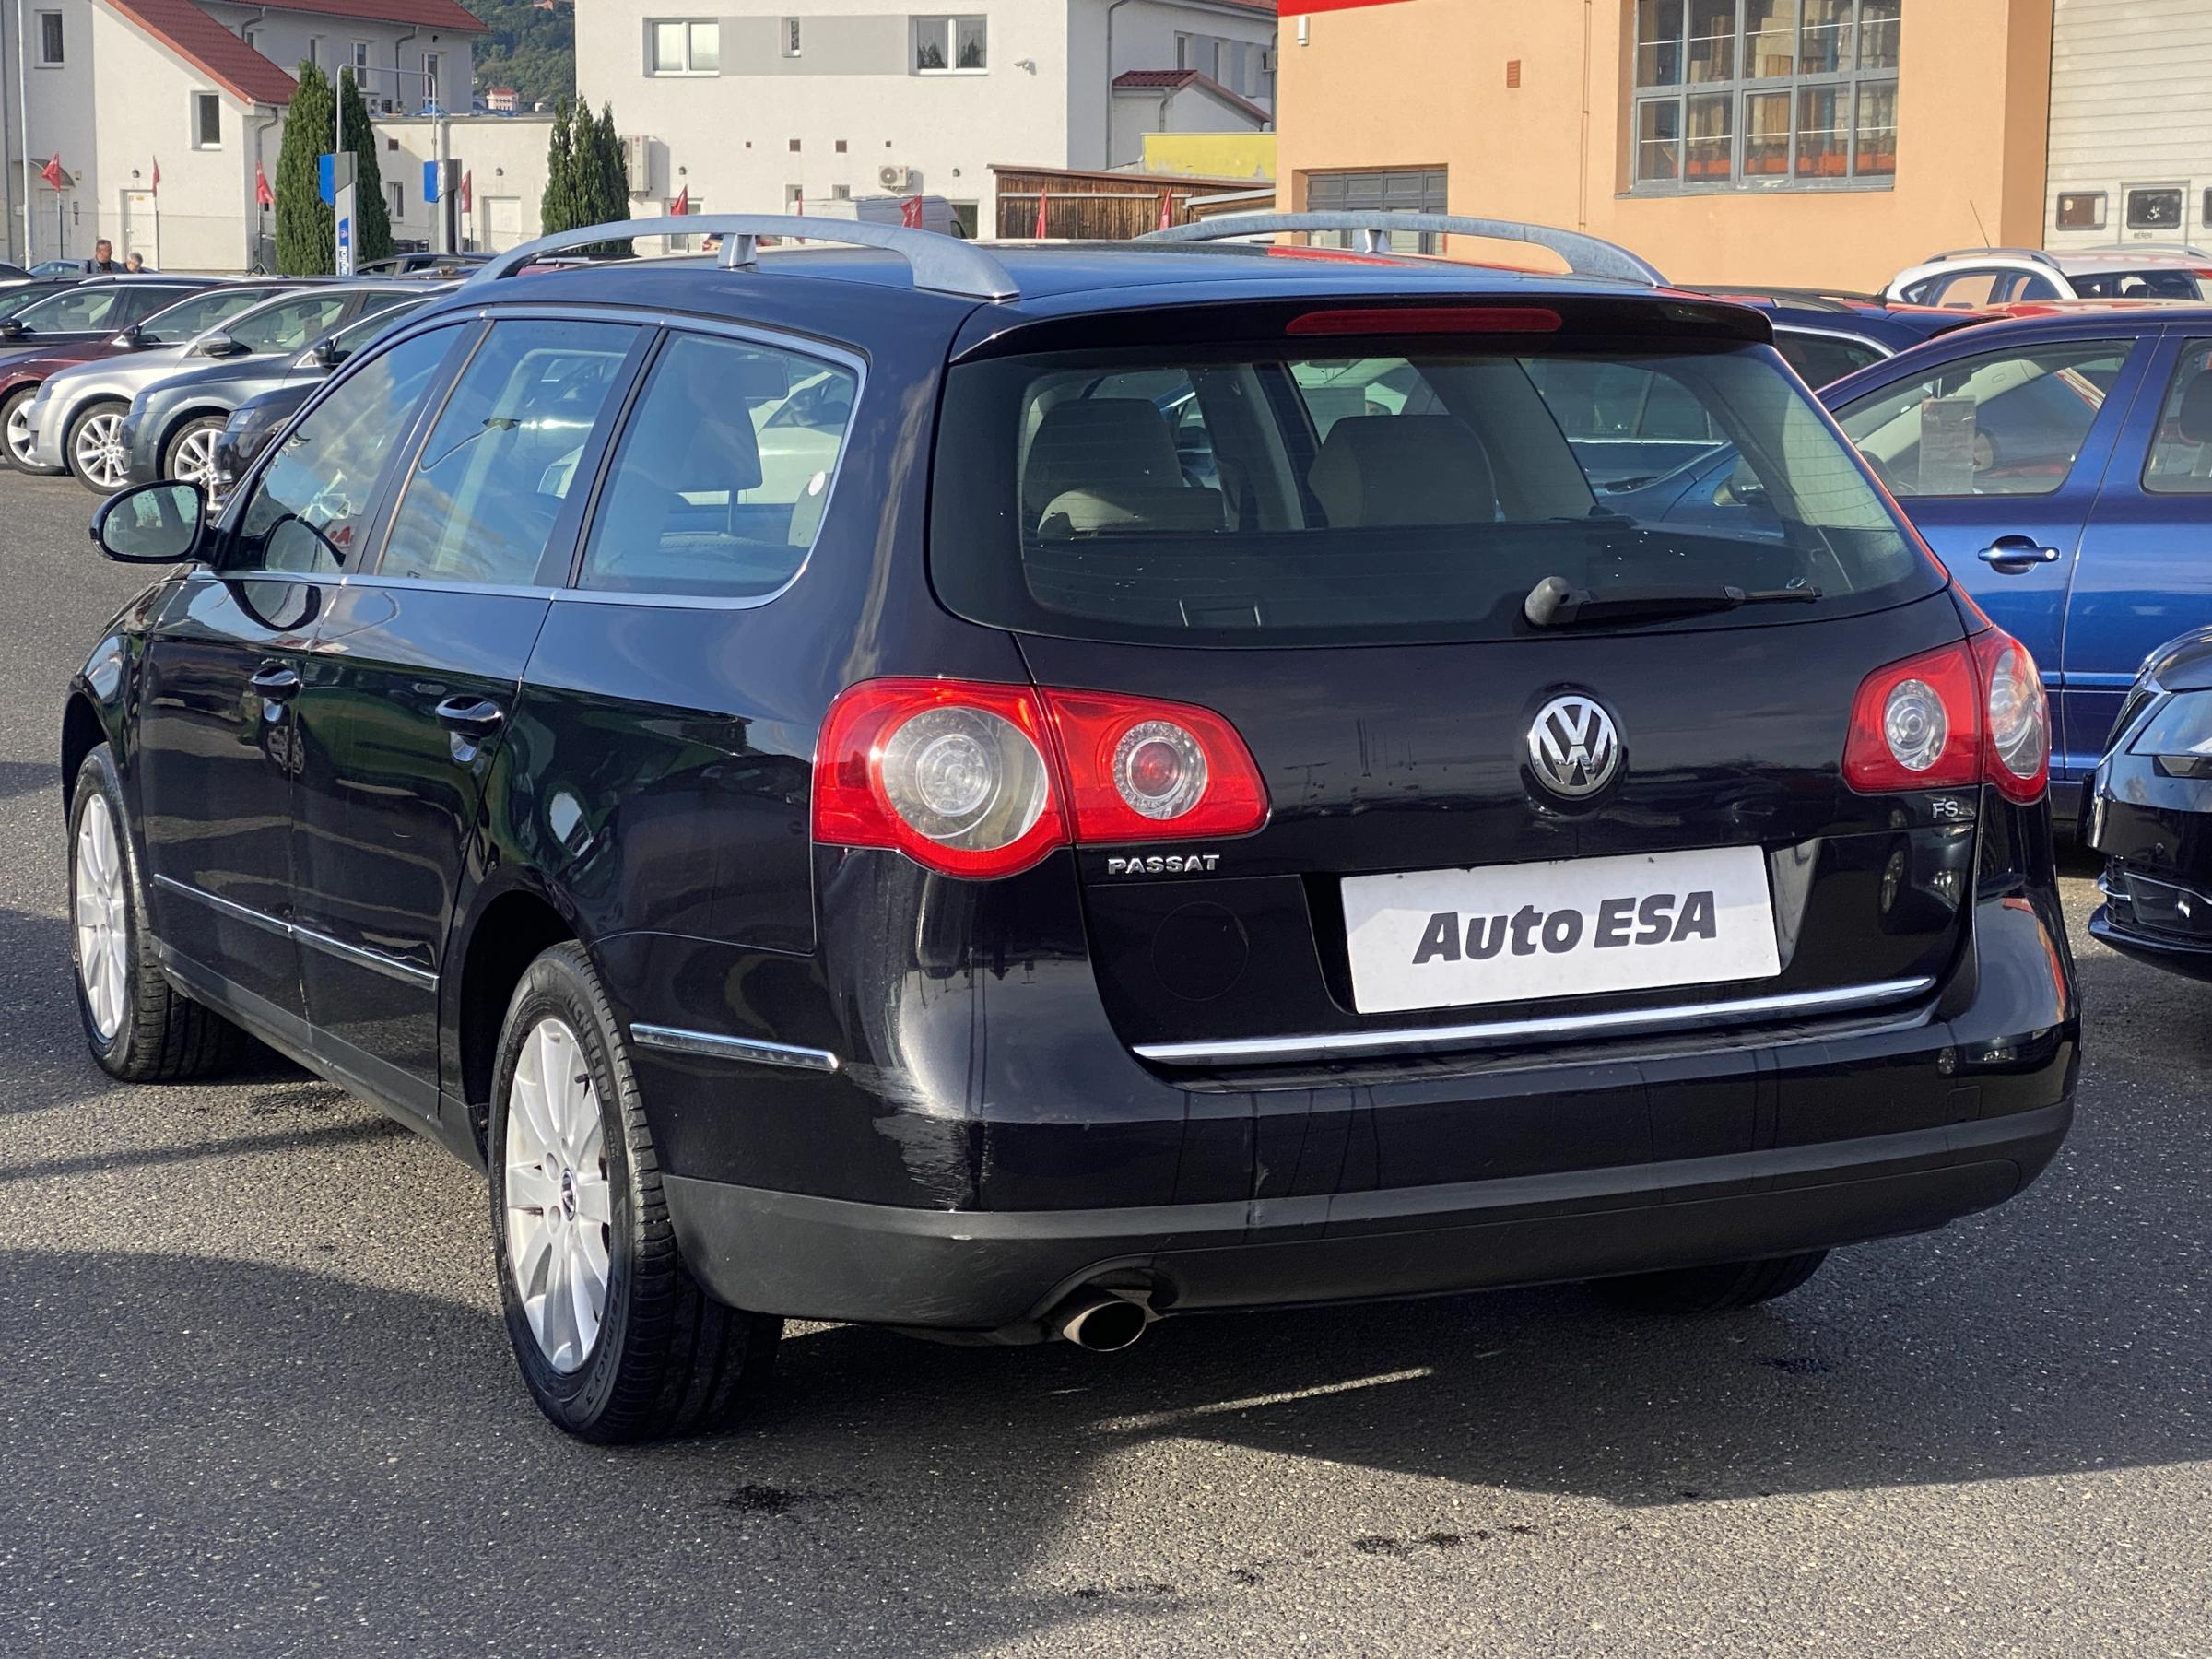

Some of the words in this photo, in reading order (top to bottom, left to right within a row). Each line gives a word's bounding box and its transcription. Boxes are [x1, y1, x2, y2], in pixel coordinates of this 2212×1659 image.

[338, 245, 349, 275] aglioli
[1107, 853, 1220, 875] PASSAT
[1412, 904, 1583, 964] Auto
[1594, 890, 1717, 948] ESA
